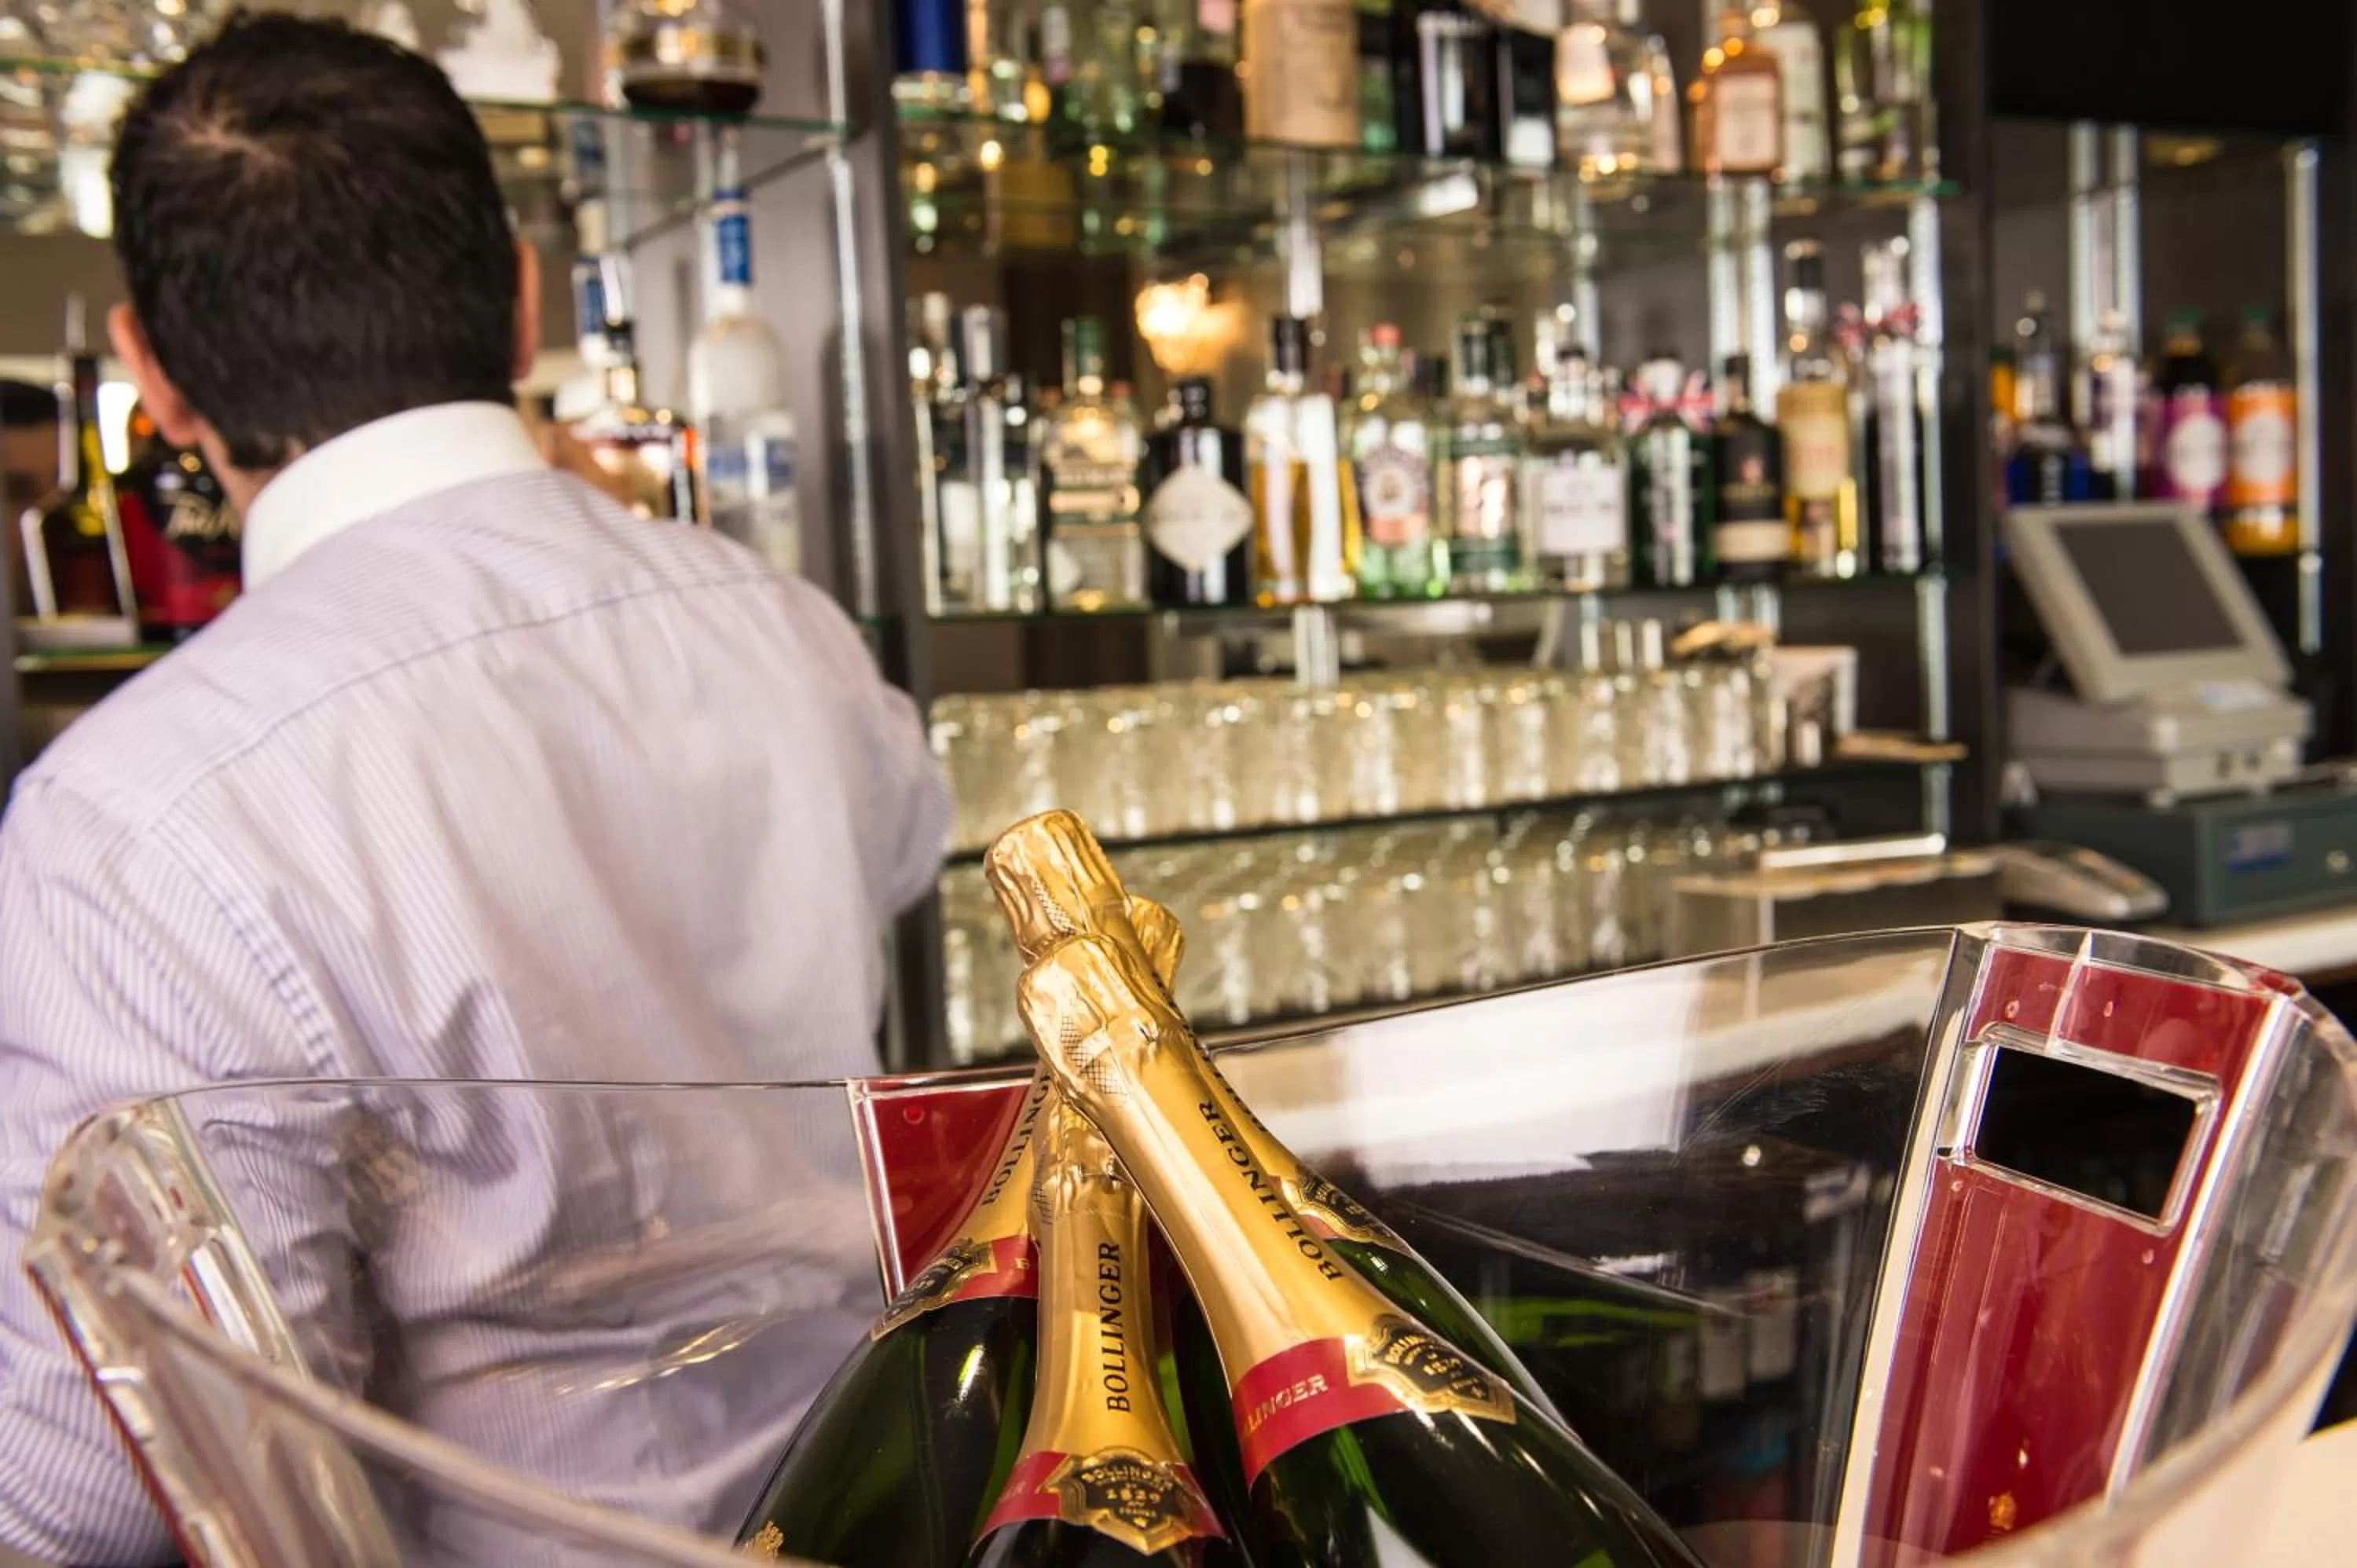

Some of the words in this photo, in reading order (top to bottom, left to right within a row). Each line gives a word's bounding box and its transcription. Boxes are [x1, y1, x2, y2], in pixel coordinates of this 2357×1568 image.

[981, 1069, 1051, 1207] BOLLING
[1199, 1101, 1343, 1281] BOLLINGER
[1098, 1242, 1131, 1412] BOLLINGER
[1244, 1373, 1329, 1437] LINGER
